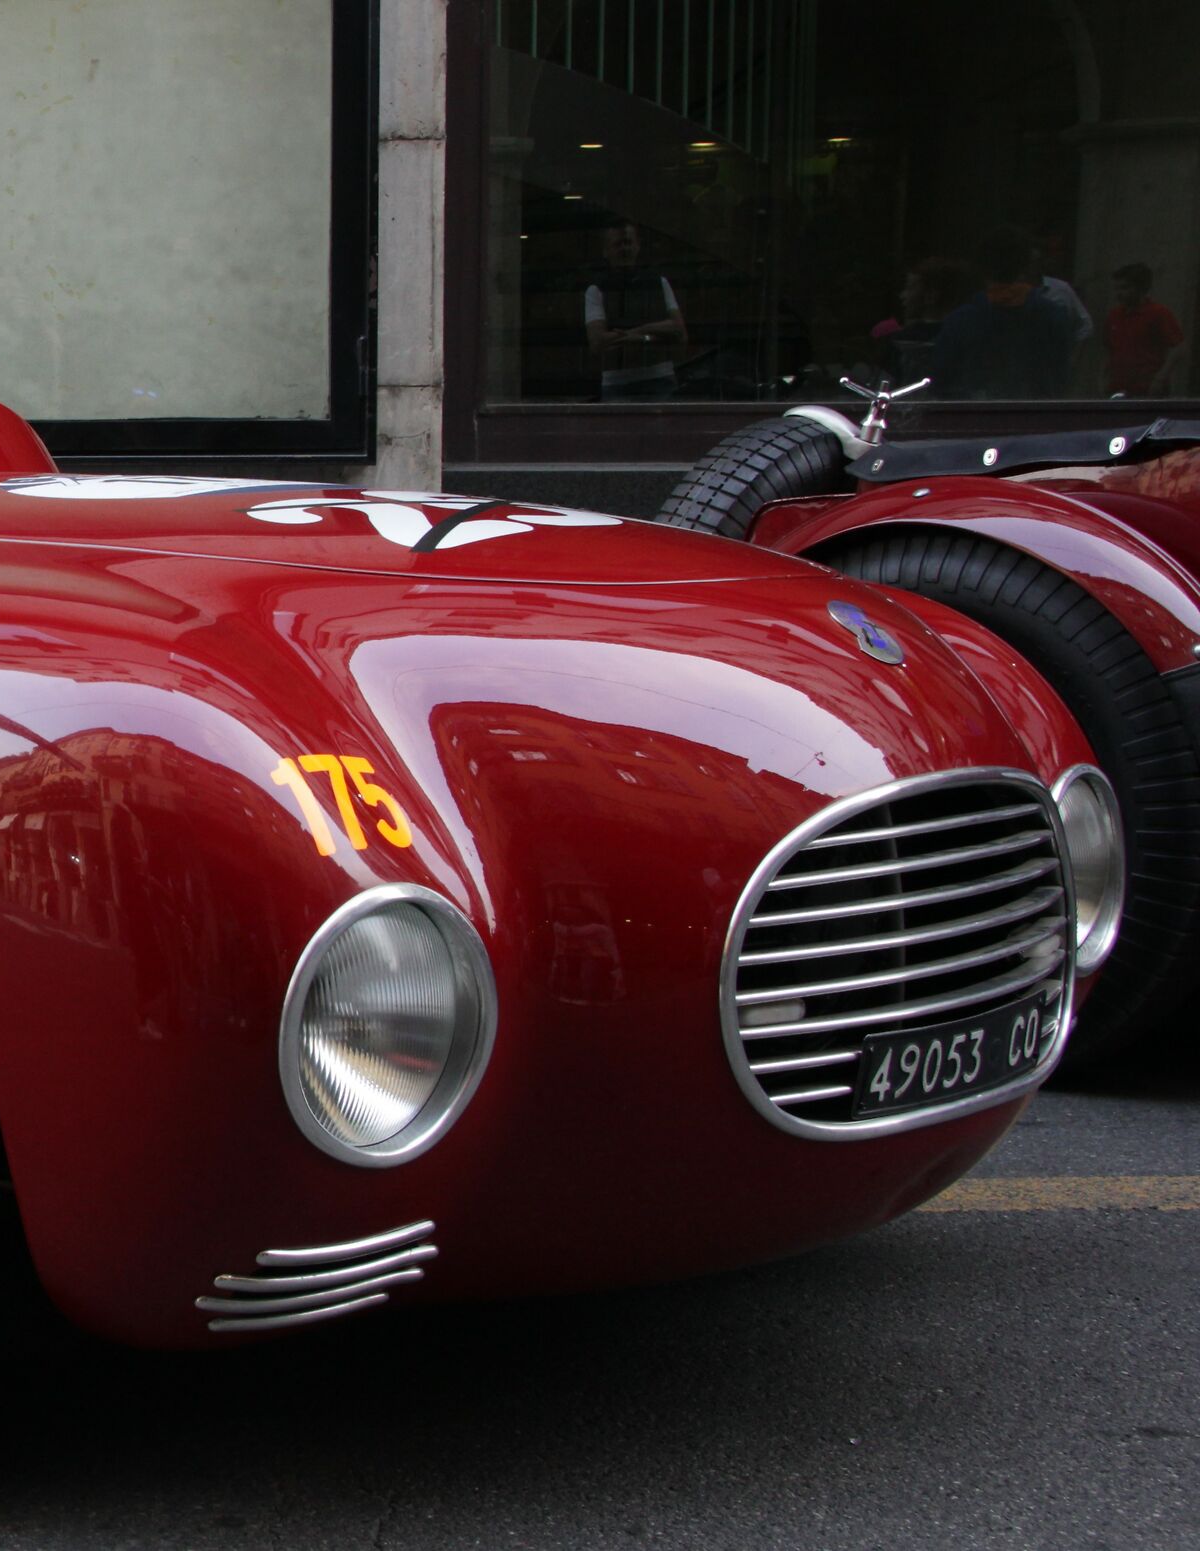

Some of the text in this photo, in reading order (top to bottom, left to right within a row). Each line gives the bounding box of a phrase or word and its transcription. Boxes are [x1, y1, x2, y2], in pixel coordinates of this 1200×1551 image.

[270, 753, 413, 857] 175
[869, 1008, 1039, 1103] 49053 CO
